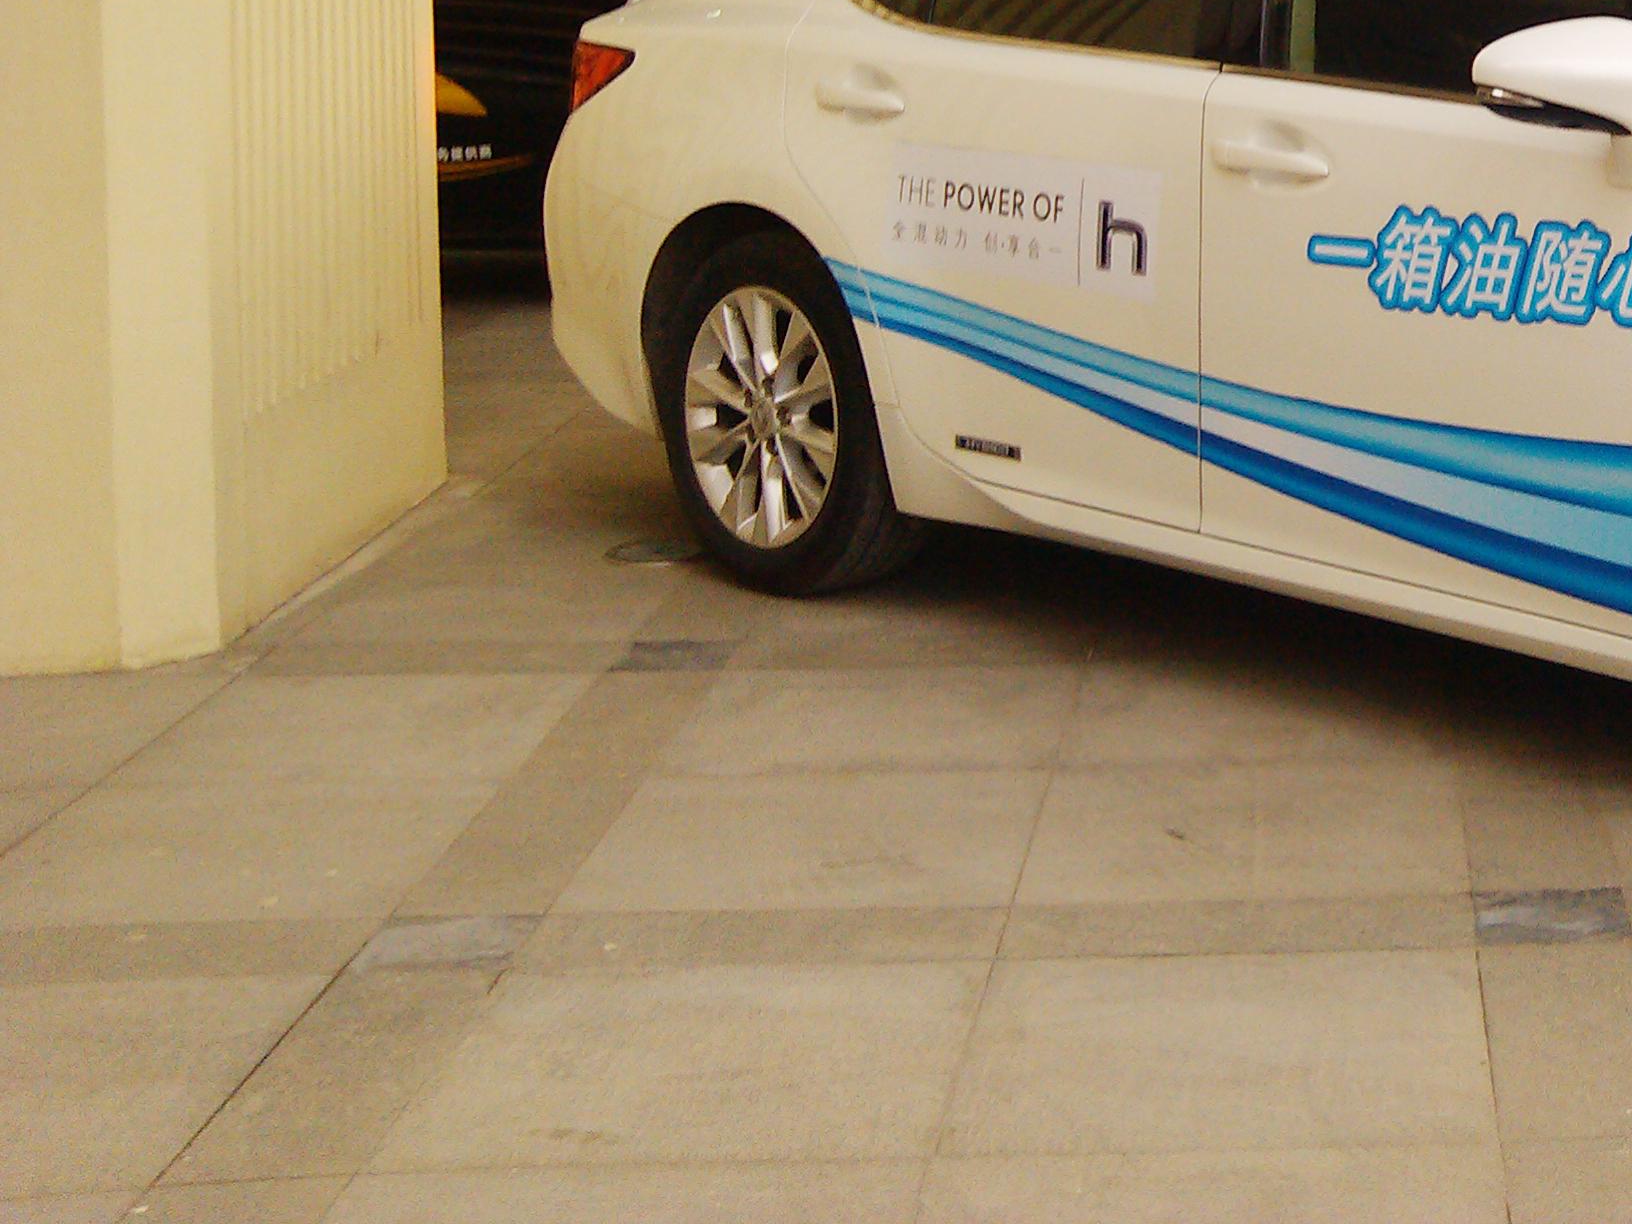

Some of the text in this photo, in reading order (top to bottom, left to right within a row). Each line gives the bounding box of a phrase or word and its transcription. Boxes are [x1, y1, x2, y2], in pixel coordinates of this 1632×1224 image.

[898, 175, 1066, 224] THE POWER OF
[1096, 199, 1149, 277] h
